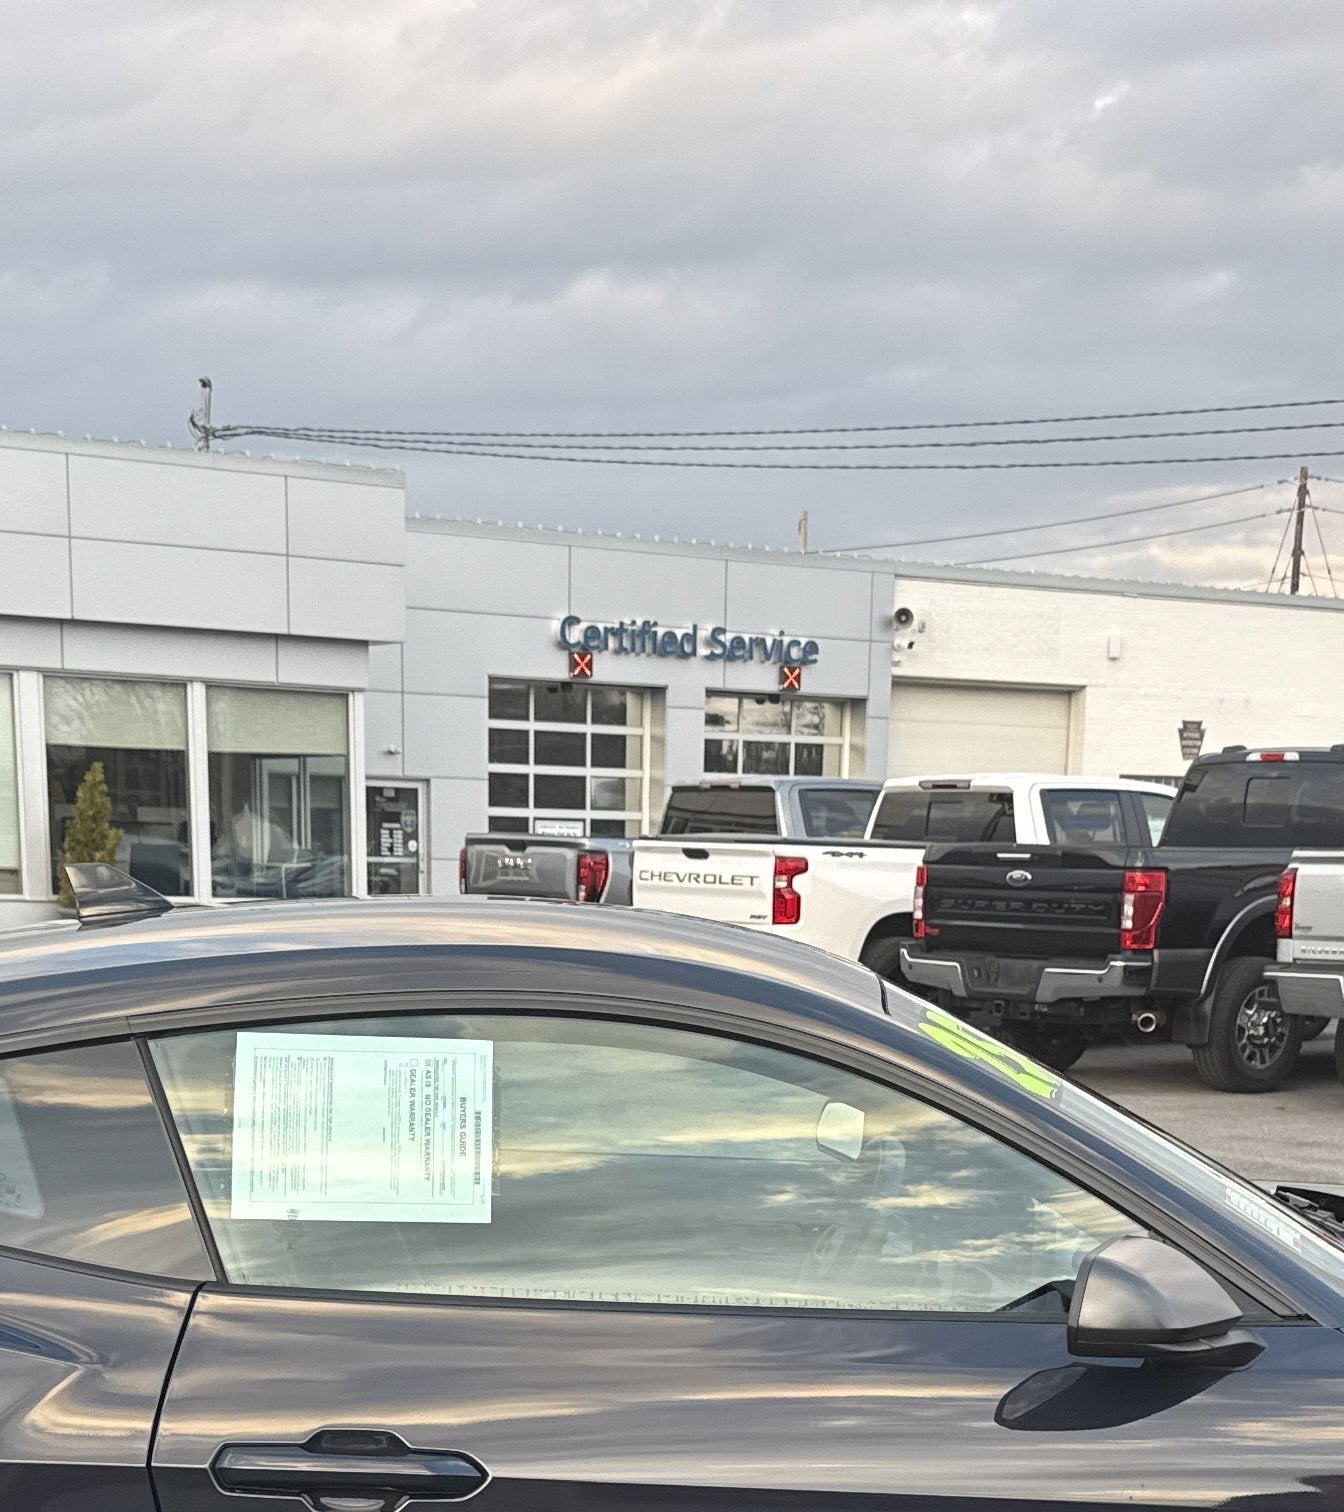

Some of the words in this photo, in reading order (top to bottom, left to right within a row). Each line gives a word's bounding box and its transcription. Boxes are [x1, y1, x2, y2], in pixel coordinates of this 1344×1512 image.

[559, 615, 698, 658] Certified
[709, 626, 819, 666] Service
[638, 870, 759, 887] CHEVROLET
[939, 898, 1026, 912] SUPER
[1031, 900, 1105, 915] DUTY
[408, 1068, 417, 1098] DEALER
[408, 1099, 416, 1142] WARRANTY
[423, 1107, 432, 1137] DEALER
[459, 1096, 468, 1130] BUYERS
[459, 1131, 467, 1158] GUIDE
[423, 1138, 432, 1182] WARRANTY
